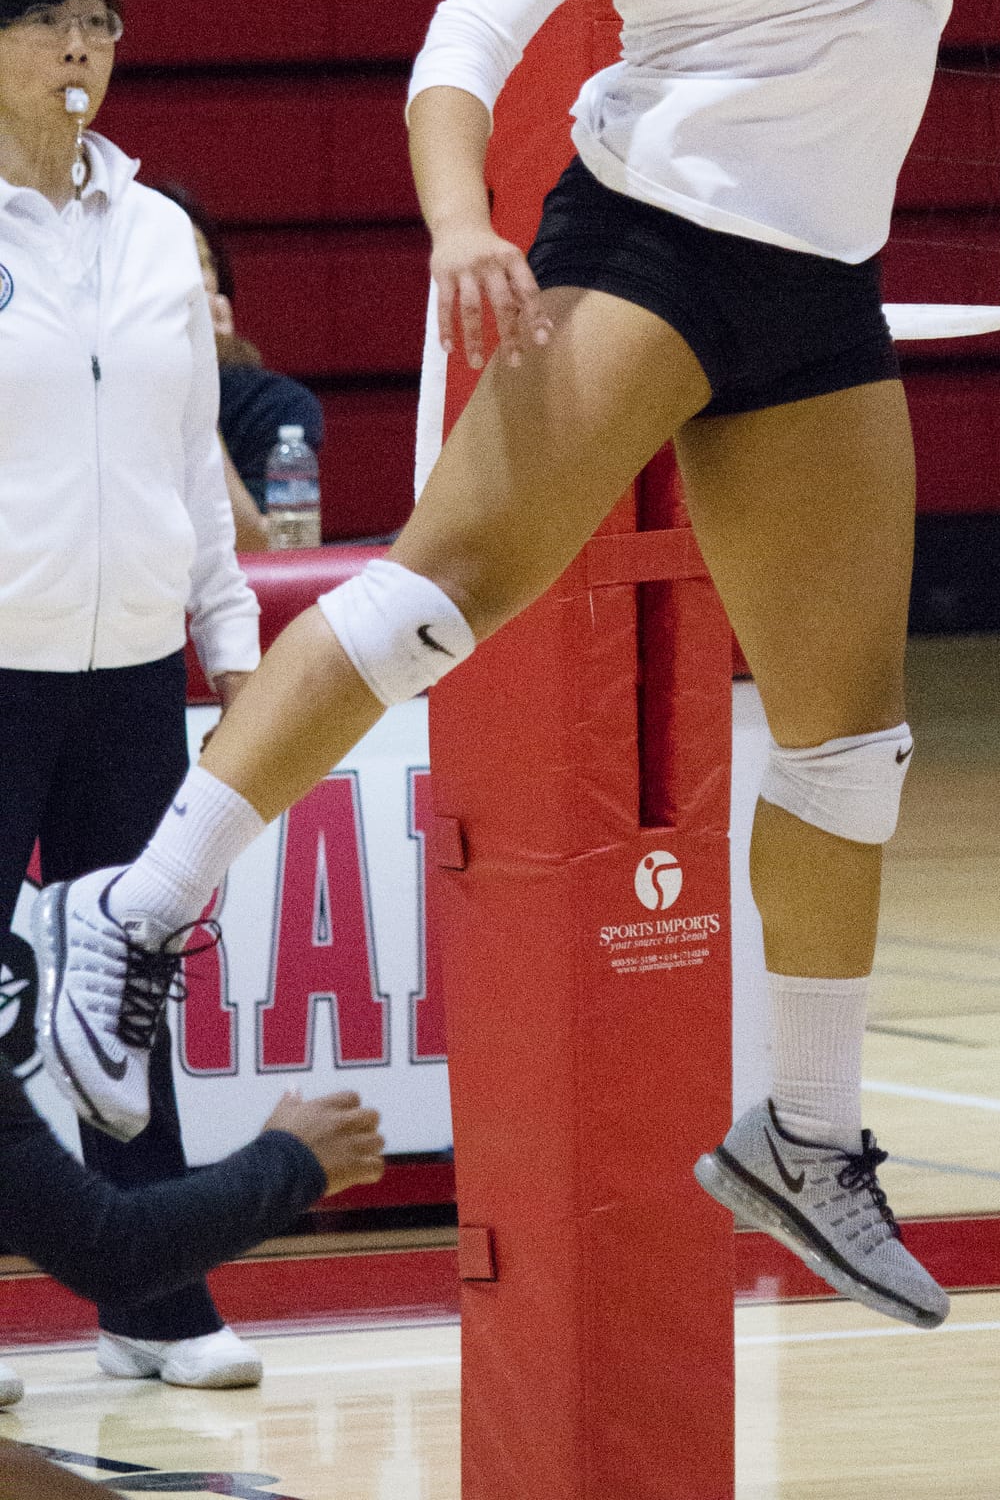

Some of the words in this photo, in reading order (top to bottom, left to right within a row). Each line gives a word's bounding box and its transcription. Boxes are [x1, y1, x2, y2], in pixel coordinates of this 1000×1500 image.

[600, 922, 653, 946] SPORTS
[656, 914, 720, 933] IMPORTS
[609, 940, 632, 953] your
[665, 934, 679, 945] for
